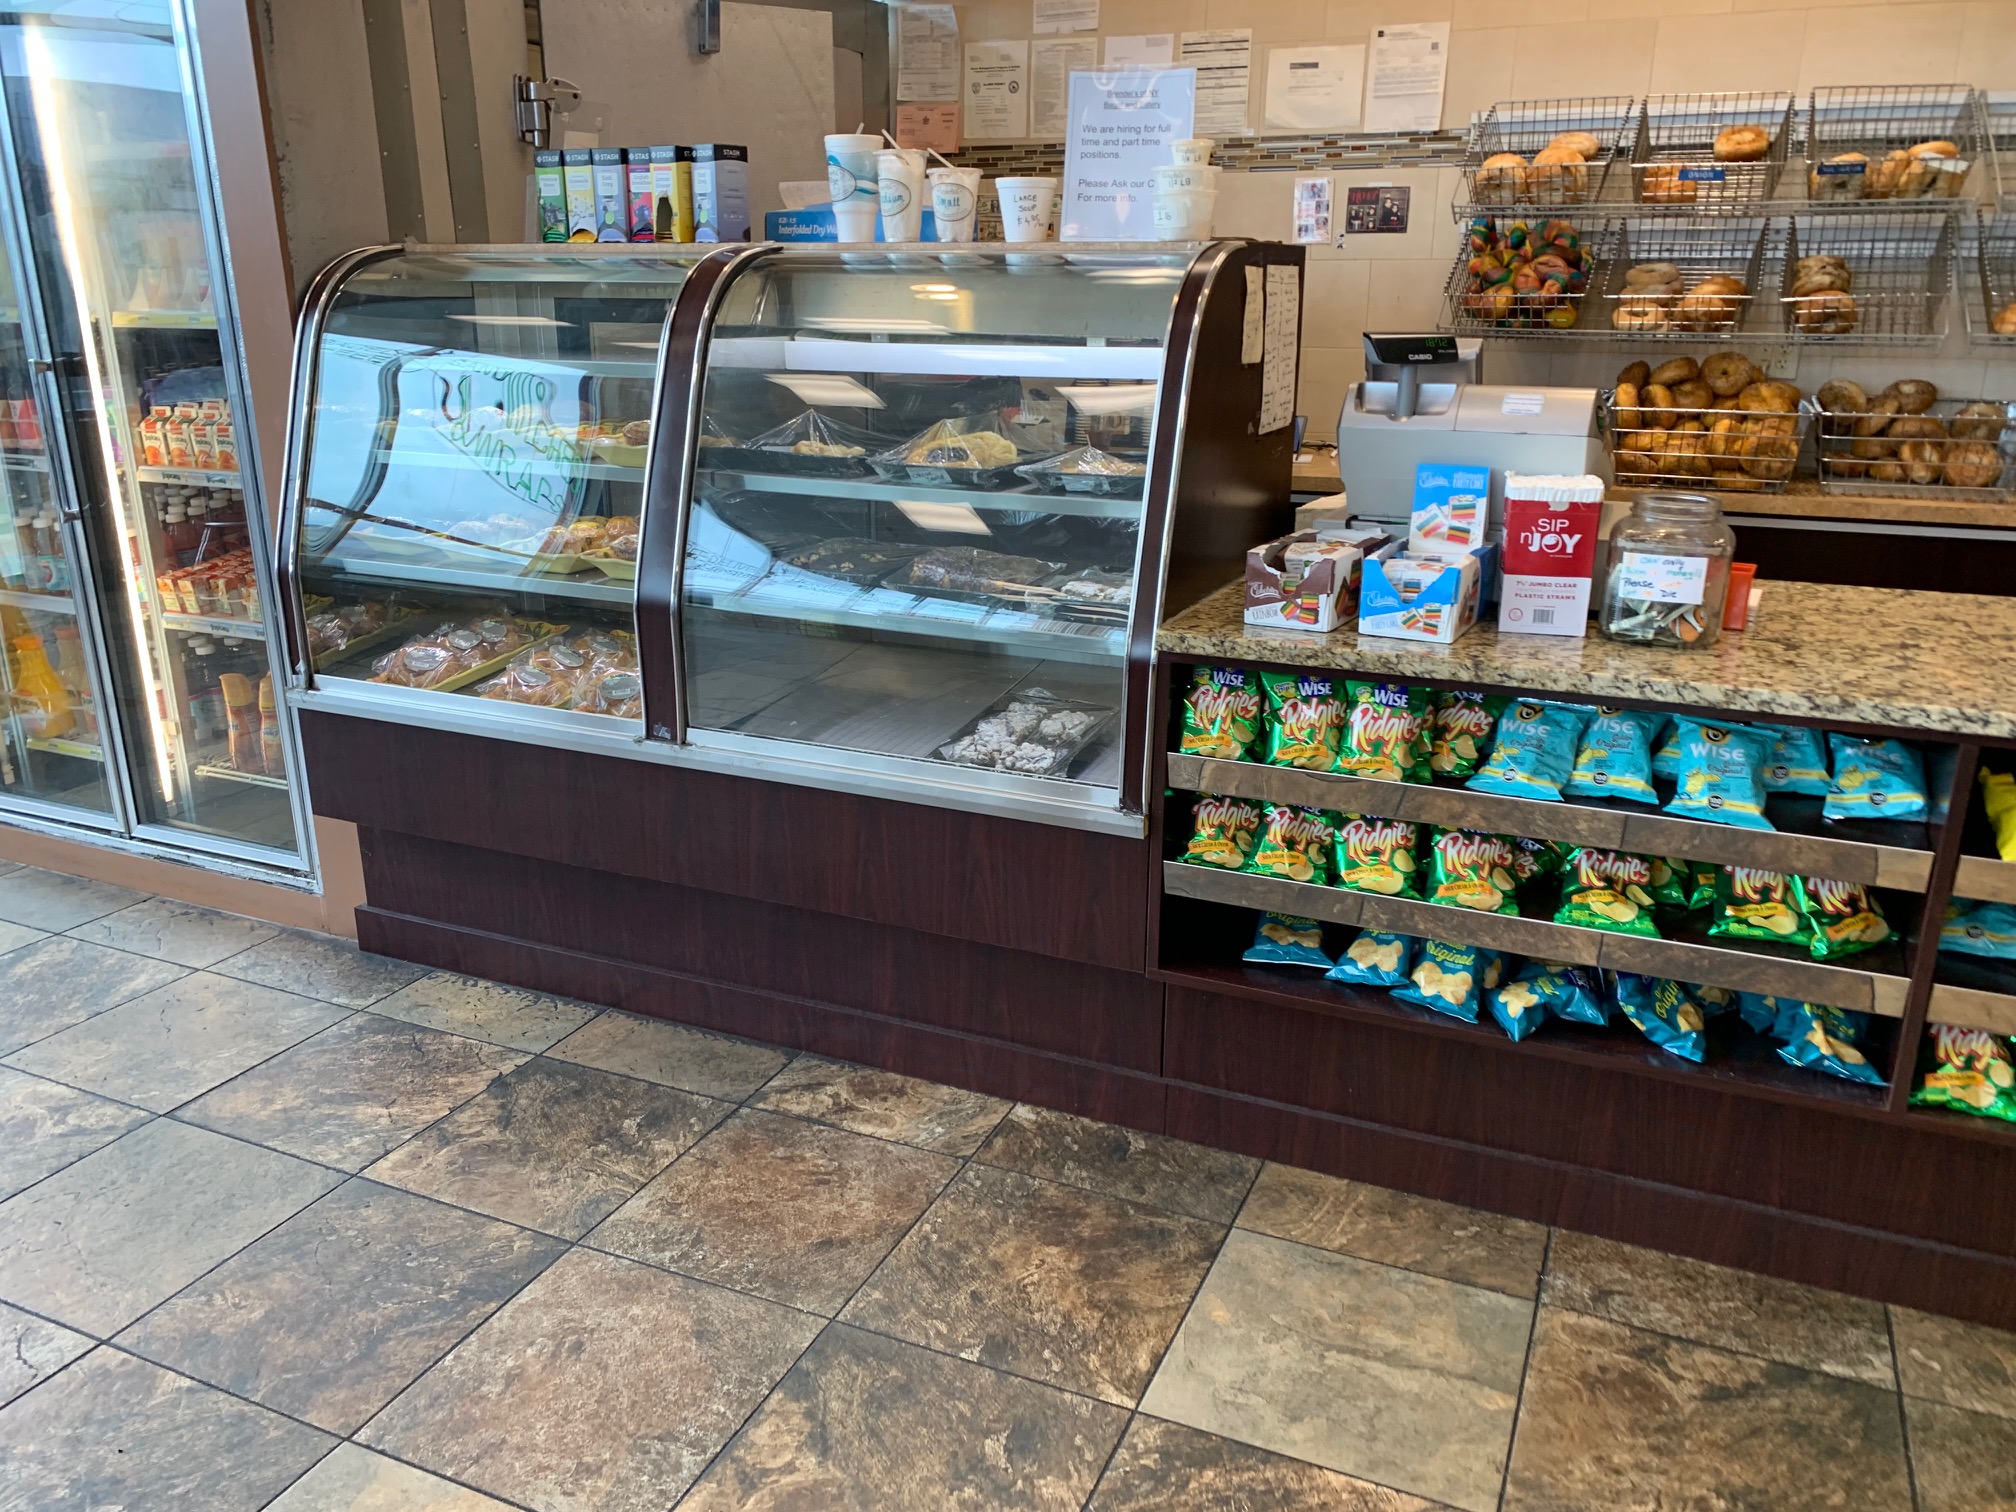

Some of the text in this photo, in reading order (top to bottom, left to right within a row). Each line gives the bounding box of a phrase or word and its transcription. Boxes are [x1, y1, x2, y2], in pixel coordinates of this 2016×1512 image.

[1082, 125, 1097, 133] We
[1117, 124, 1141, 135] hiring
[1144, 124, 1155, 132] for
[1158, 124, 1171, 132] full
[1081, 137, 1160, 147] time and part time
[656, 151, 674, 159] STASH
[1080, 149, 1121, 160] positions.
[1078, 178, 1108, 188] Please
[1112, 179, 1127, 188] Ask
[1131, 180, 1144, 188] our
[1180, 177, 1191, 186] LB
[1078, 193, 1092, 202] For
[1095, 194, 1116, 202] more
[778, 224, 838, 237] Interfolded Dry Wa
[1537, 518, 1570, 532] SIP
[1514, 592, 1544, 600] PLASTIC
[1213, 671, 1244, 686] WISE
[1298, 682, 1333, 696] WISE
[1374, 689, 1409, 707] WISE
[1190, 684, 1260, 732] Ridgies
[1350, 703, 1421, 754] Ridgies
[1437, 700, 1494, 741] dgies
[1501, 718, 1552, 738] WISE
[1690, 743, 1746, 761] WISE
[1192, 797, 1260, 839] Ridgies
[1266, 807, 1334, 852] Ridgies
[1341, 820, 1417, 863] Ridgies
[1439, 832, 1513, 879] Ridgies
[1574, 849, 1651, 892] Ridgies
[1427, 940, 1475, 966] Original
